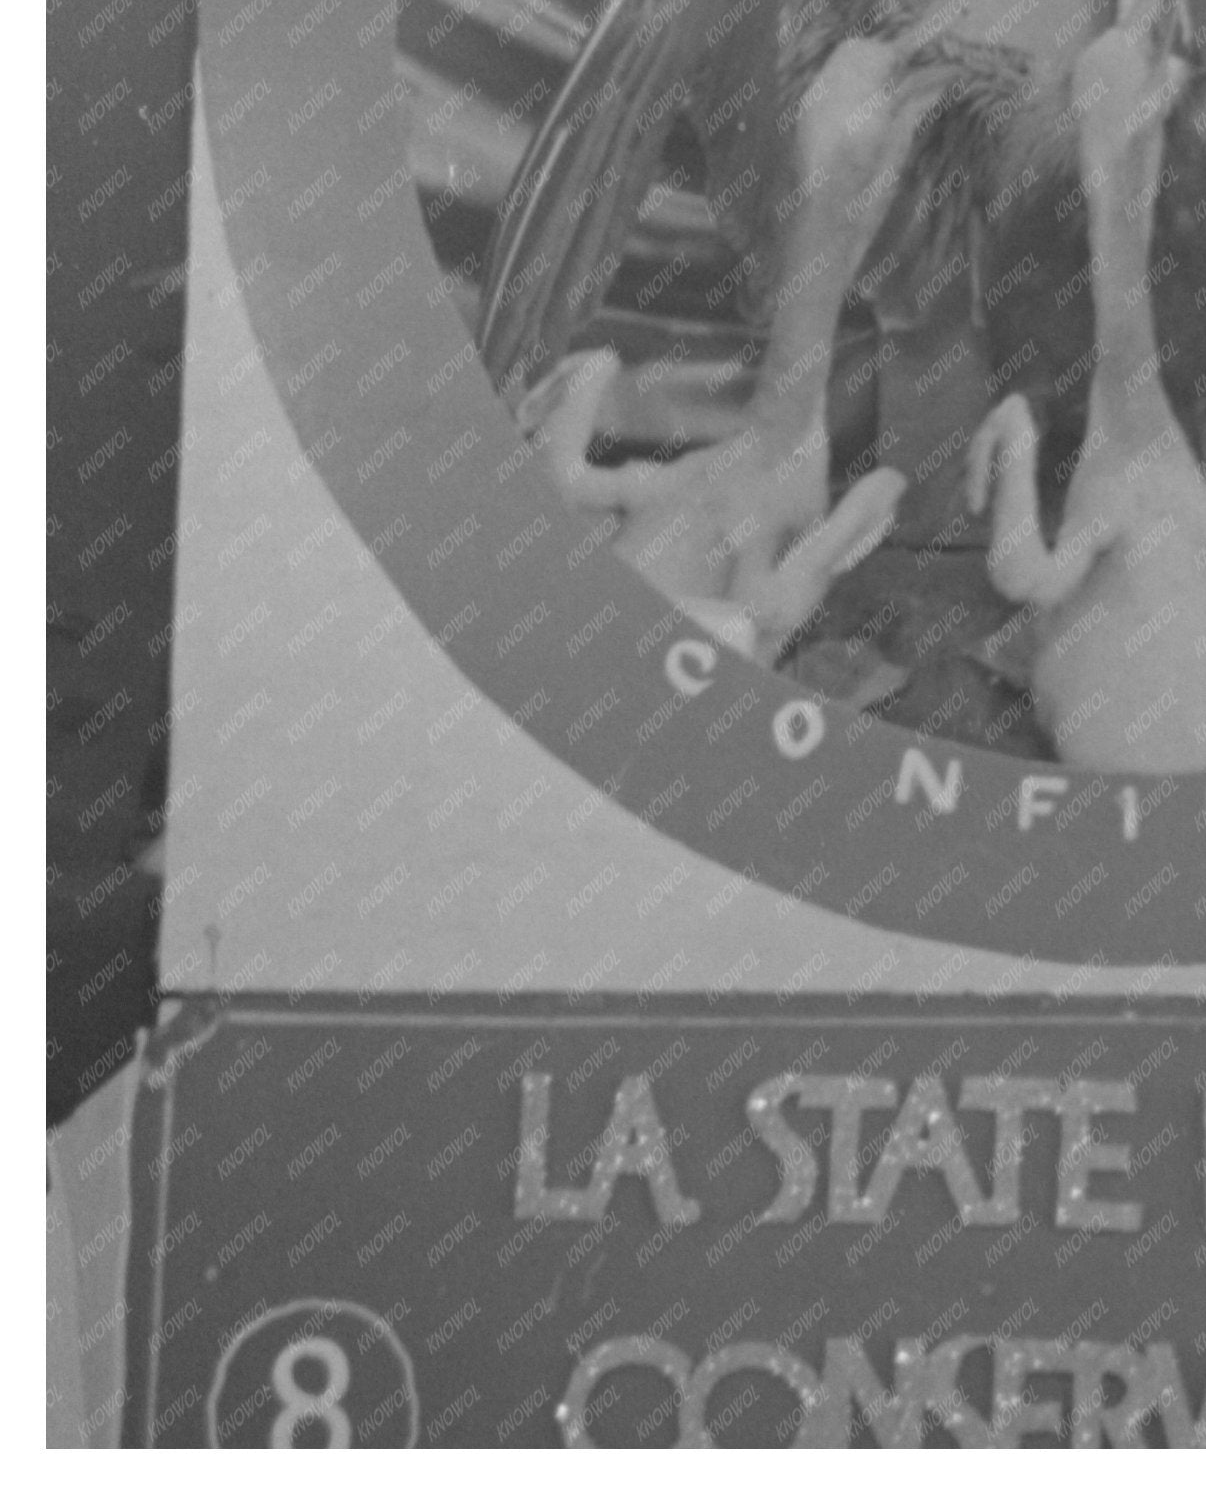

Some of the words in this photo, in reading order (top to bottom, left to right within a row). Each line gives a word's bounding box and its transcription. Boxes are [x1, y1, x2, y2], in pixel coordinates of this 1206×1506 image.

[513, 1071, 701, 1221] LA
[745, 1072, 1145, 1232] STATE
[271, 1336, 353, 1449] 8
